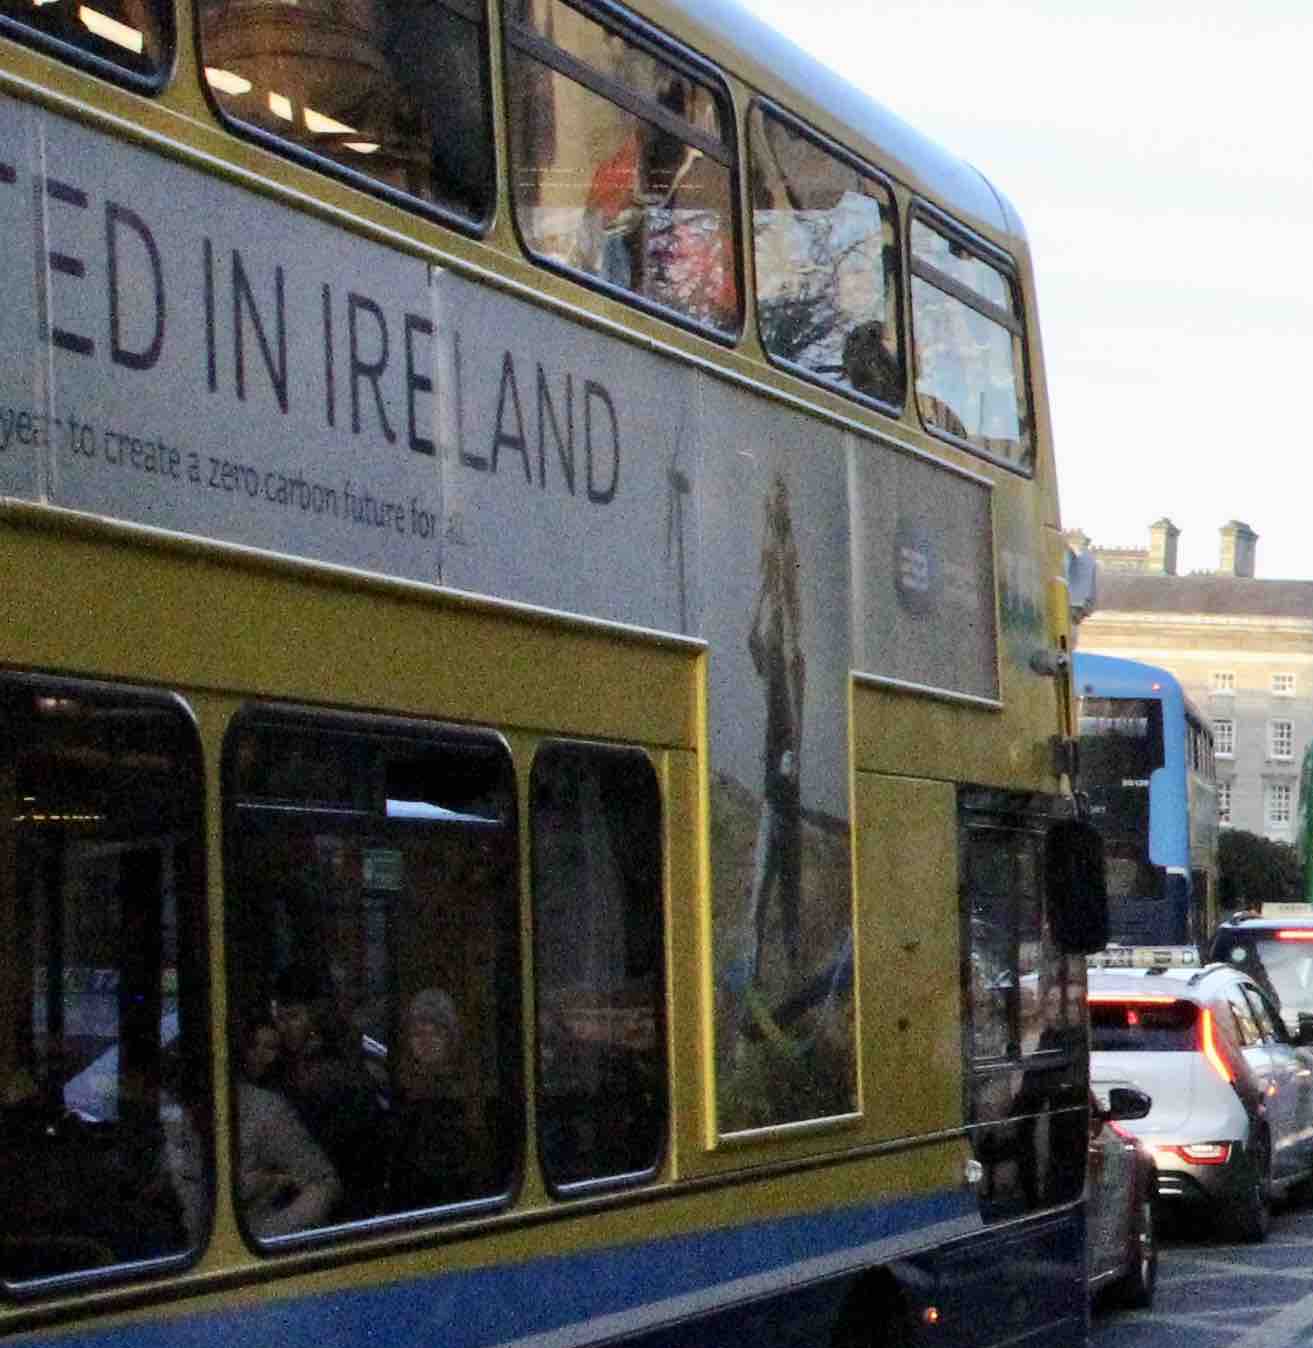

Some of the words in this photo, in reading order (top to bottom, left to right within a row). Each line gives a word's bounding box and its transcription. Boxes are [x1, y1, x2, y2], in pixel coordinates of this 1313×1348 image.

[0, 163, 166, 372] ED
[203, 236, 290, 415] IN
[322, 281, 621, 505] IRELAND
